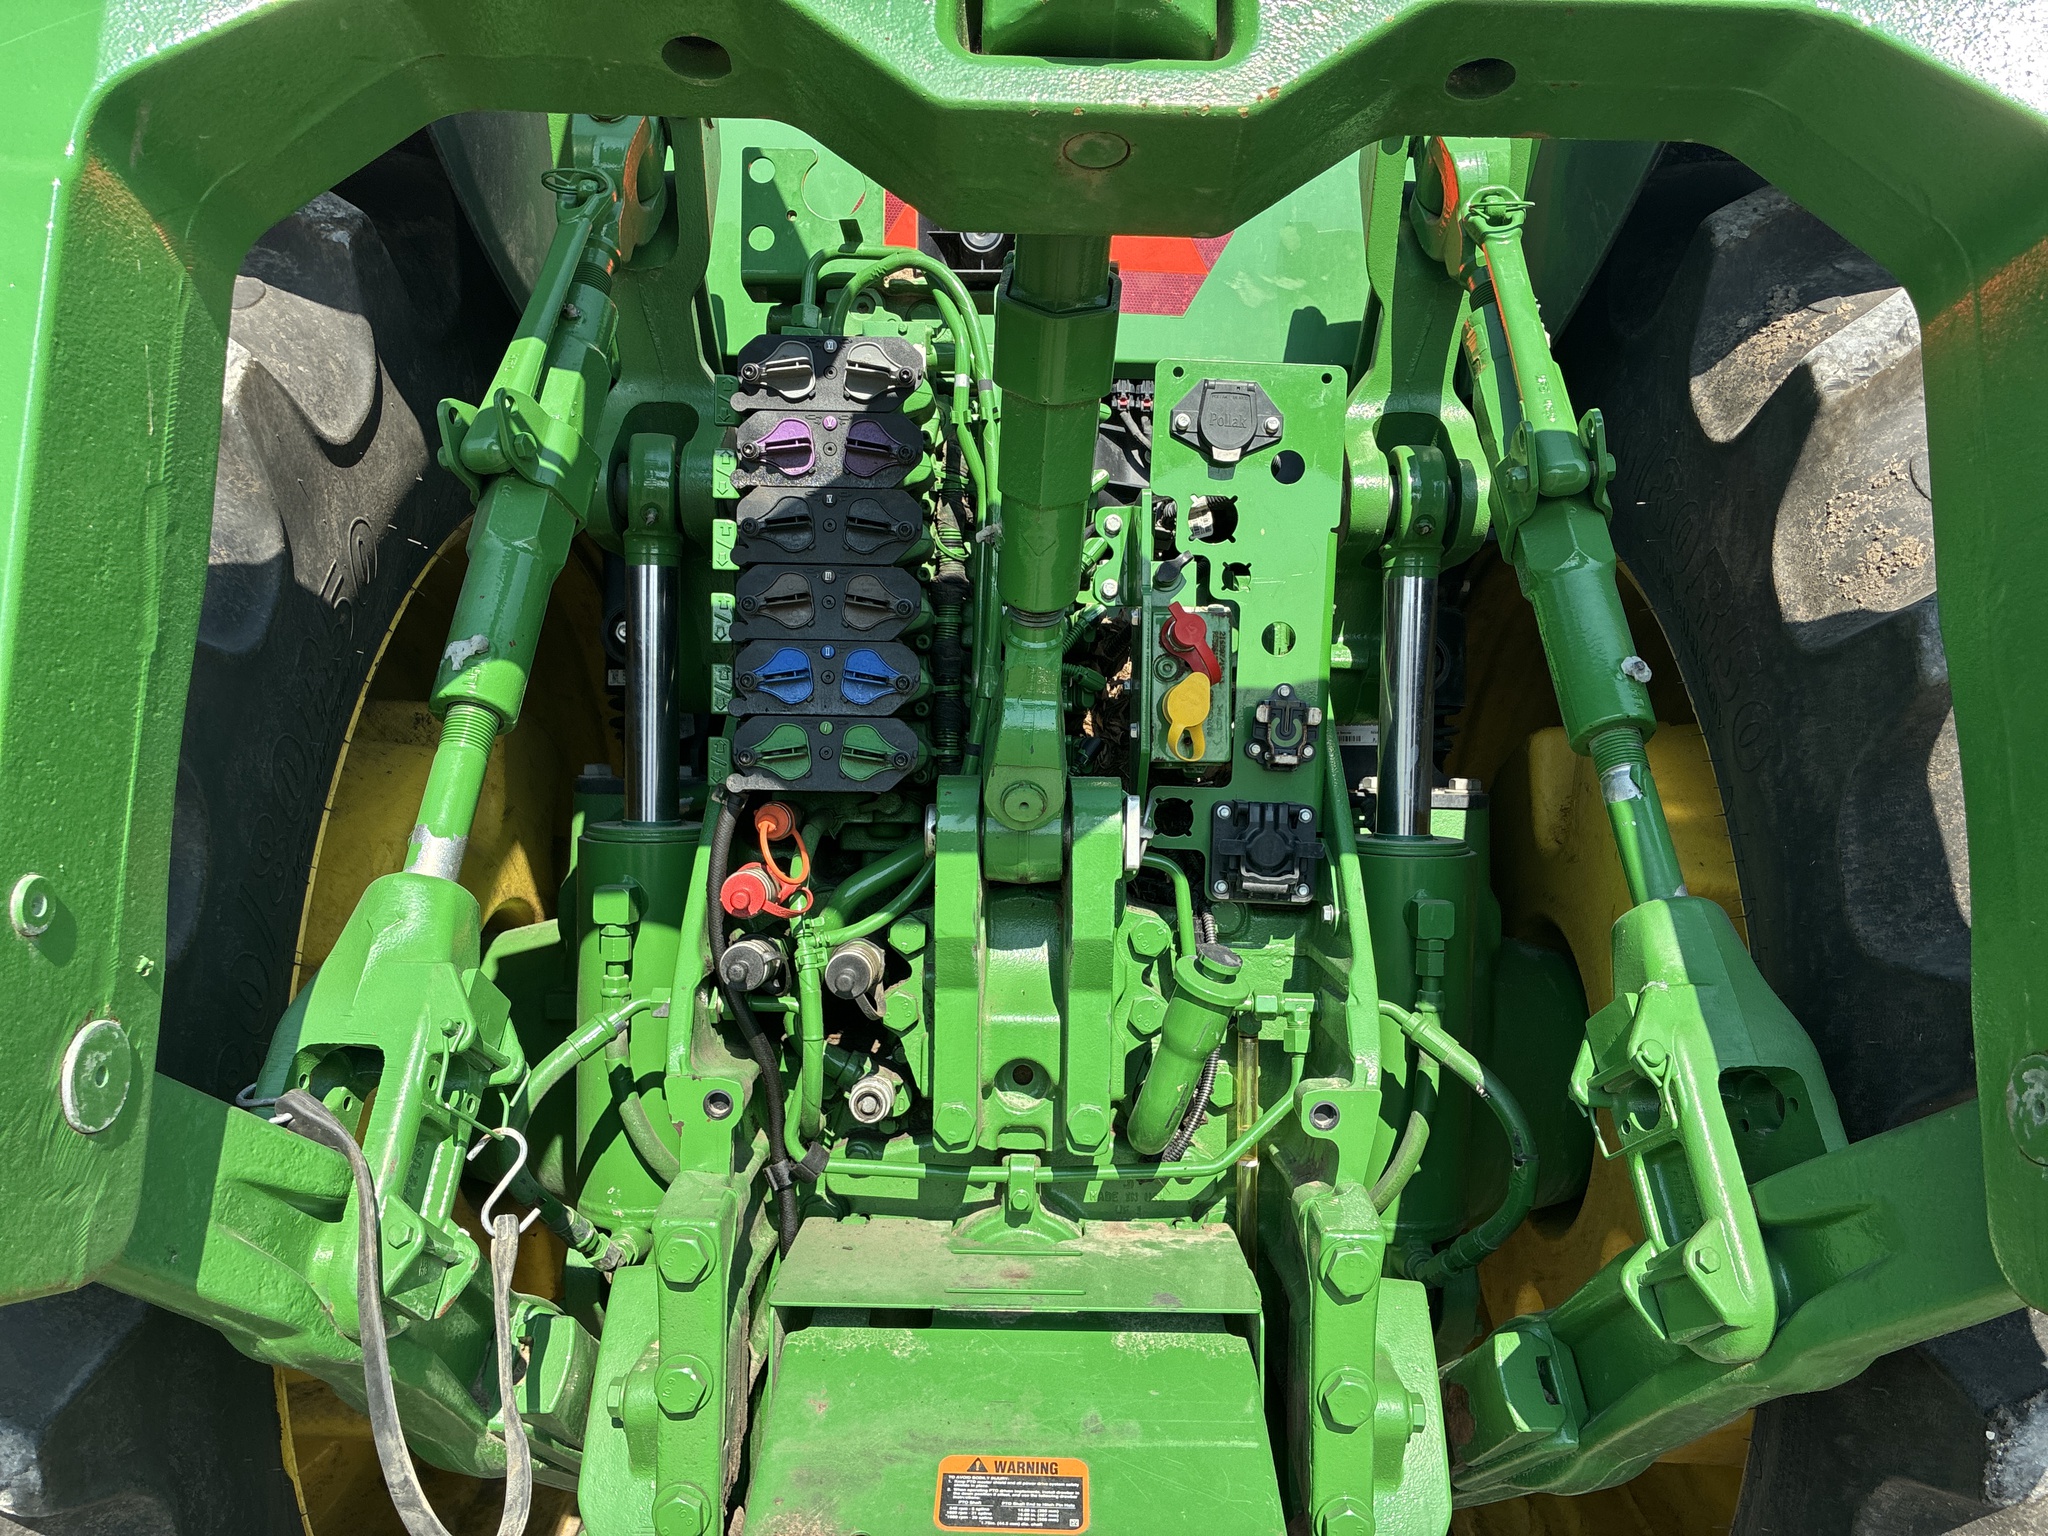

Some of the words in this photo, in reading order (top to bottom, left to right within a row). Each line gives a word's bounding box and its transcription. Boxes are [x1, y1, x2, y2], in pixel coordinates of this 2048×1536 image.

[826, 418, 833, 427] V
[1208, 411, 1247, 428] Pollak
[1090, 1190, 1118, 1202] MADE
[1126, 1192, 1138, 1202] IN
[994, 1460, 1059, 1474] WARNING
